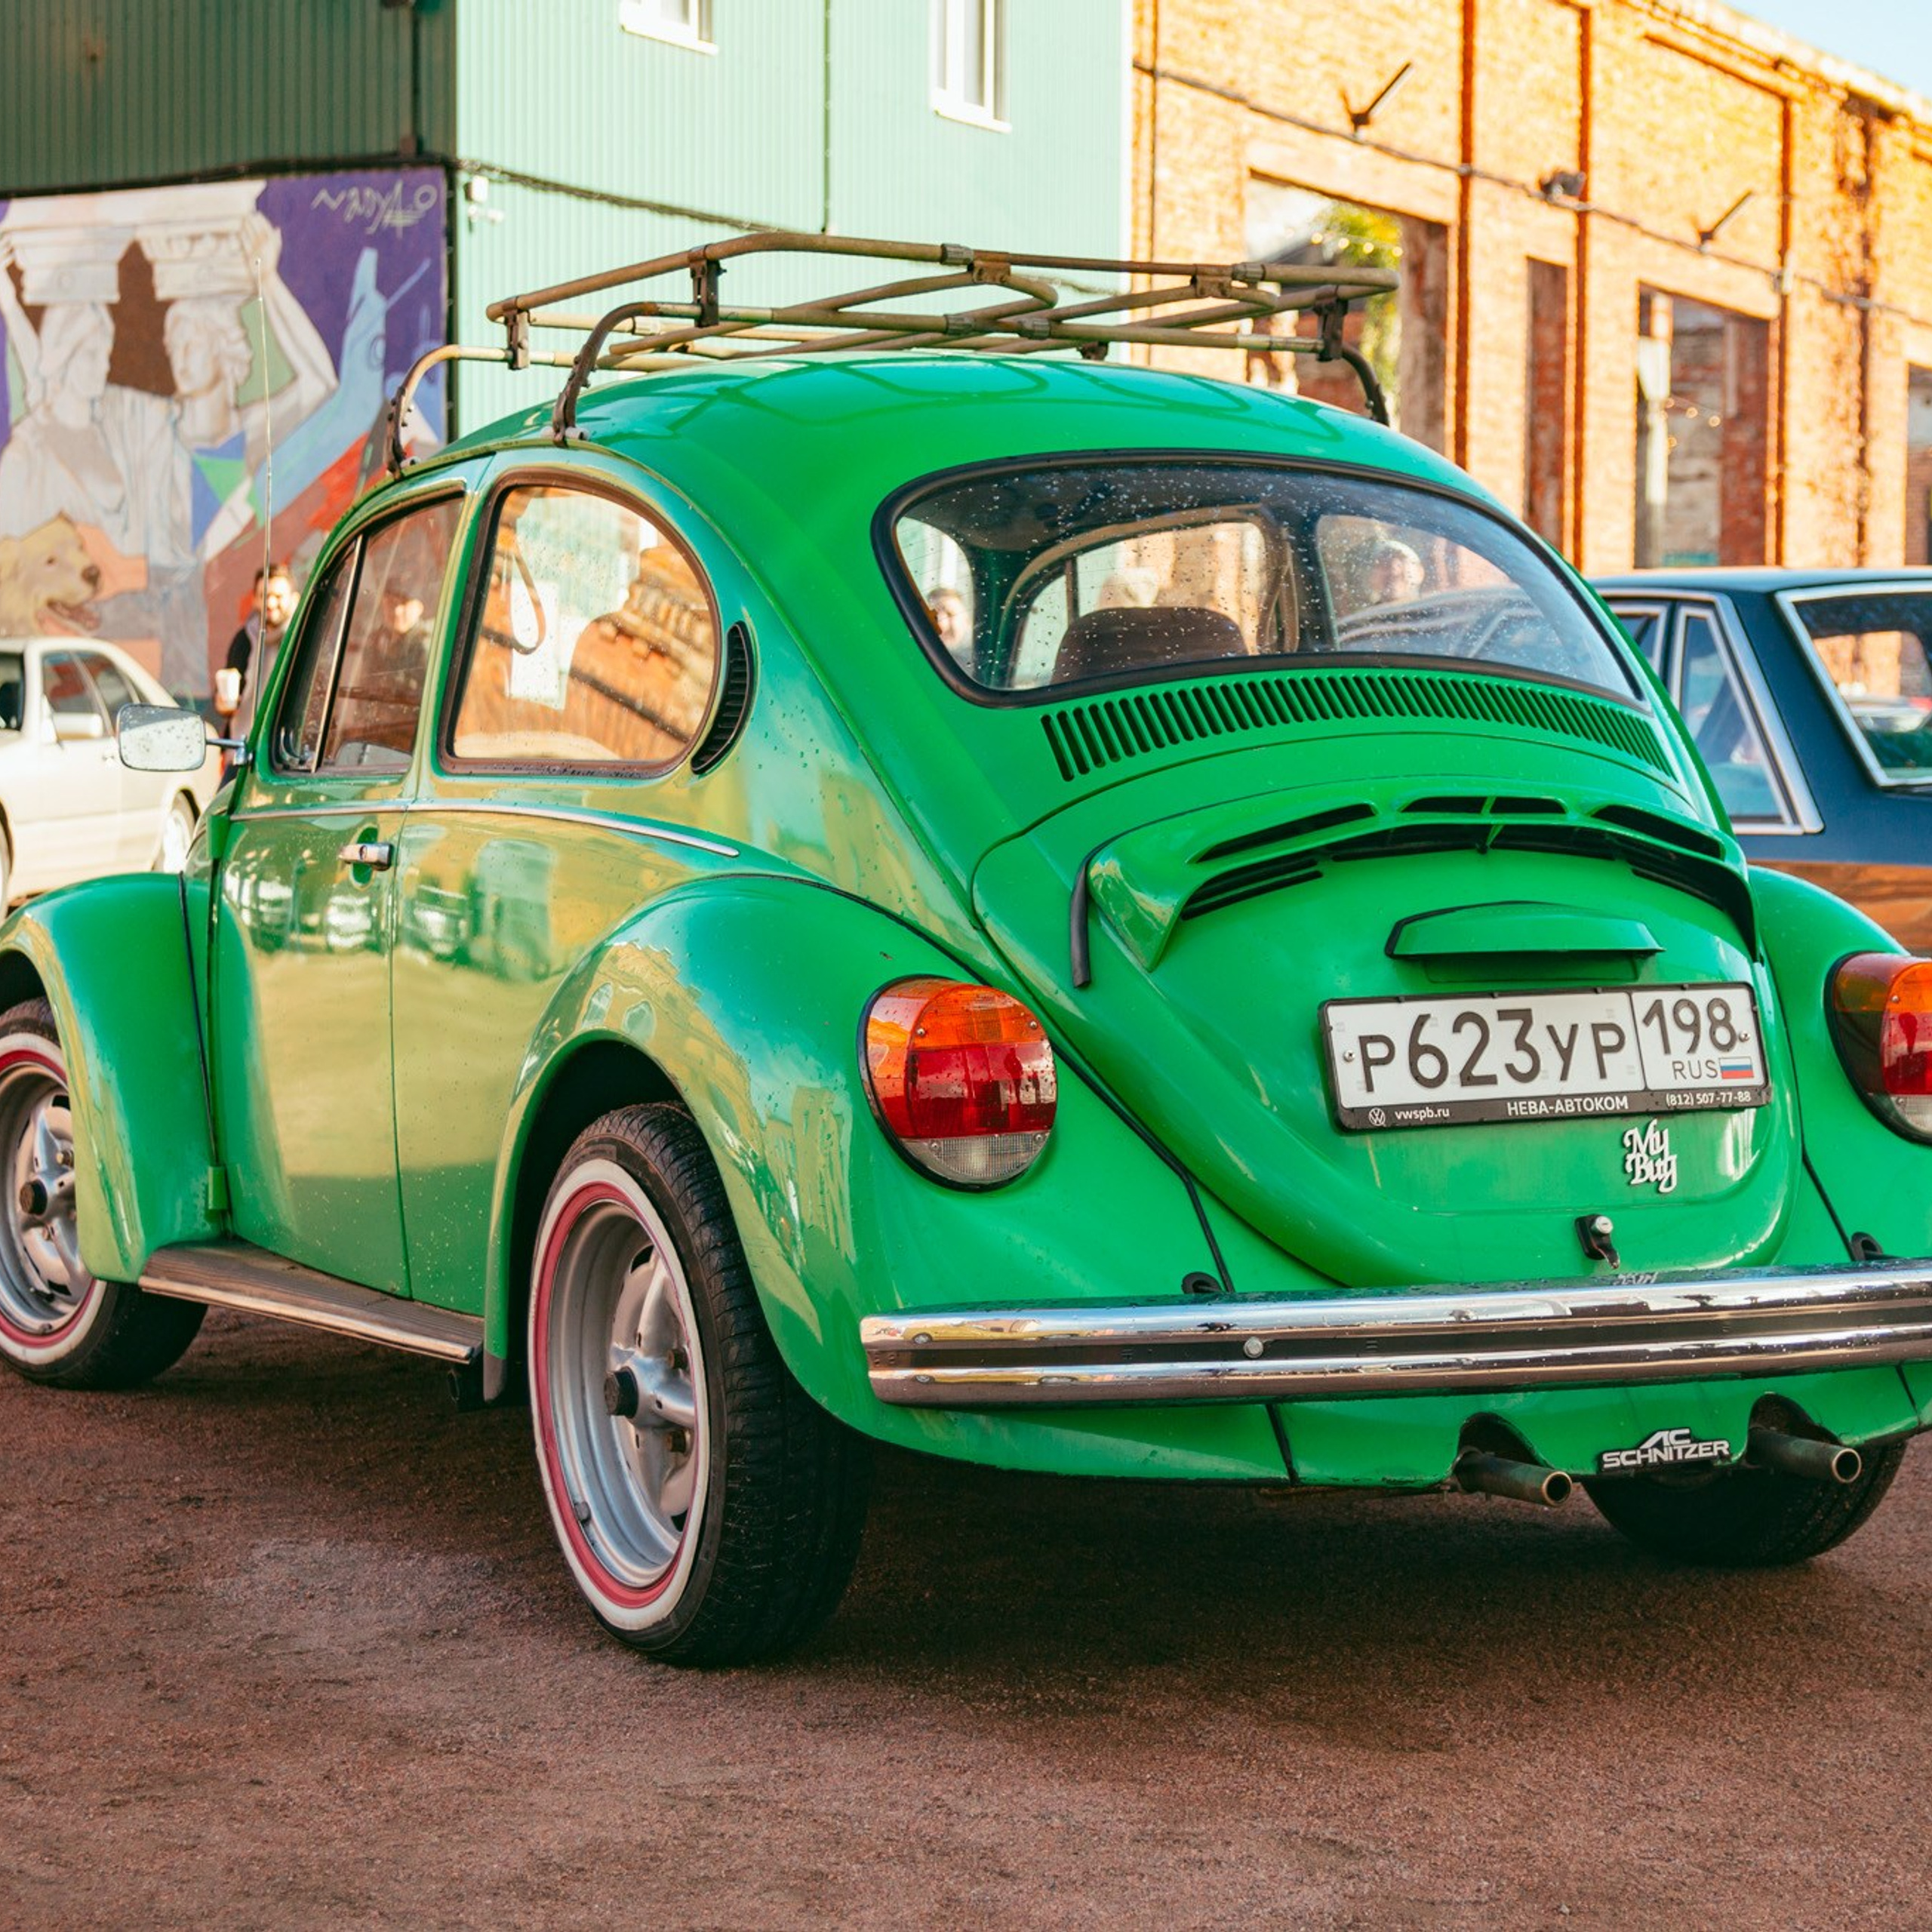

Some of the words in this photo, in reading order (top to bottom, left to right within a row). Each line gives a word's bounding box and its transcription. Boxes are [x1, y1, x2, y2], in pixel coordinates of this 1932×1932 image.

[1358, 1008, 1626, 1092] Р623УР
[1642, 998, 1737, 1055] 198
[1672, 1060, 1718, 1080] RUS
[1507, 1095, 1629, 1116] НЕВА-АВТОКОМ
[1666, 1092, 1694, 1107] (812)
[1394, 1106, 1450, 1121] vwspb.ru
[1623, 1118, 1669, 1162] My
[1625, 1153, 1677, 1193] Bug
[1639, 1428, 1691, 1449] AC
[1601, 1440, 1730, 1469] SCHNITZER
